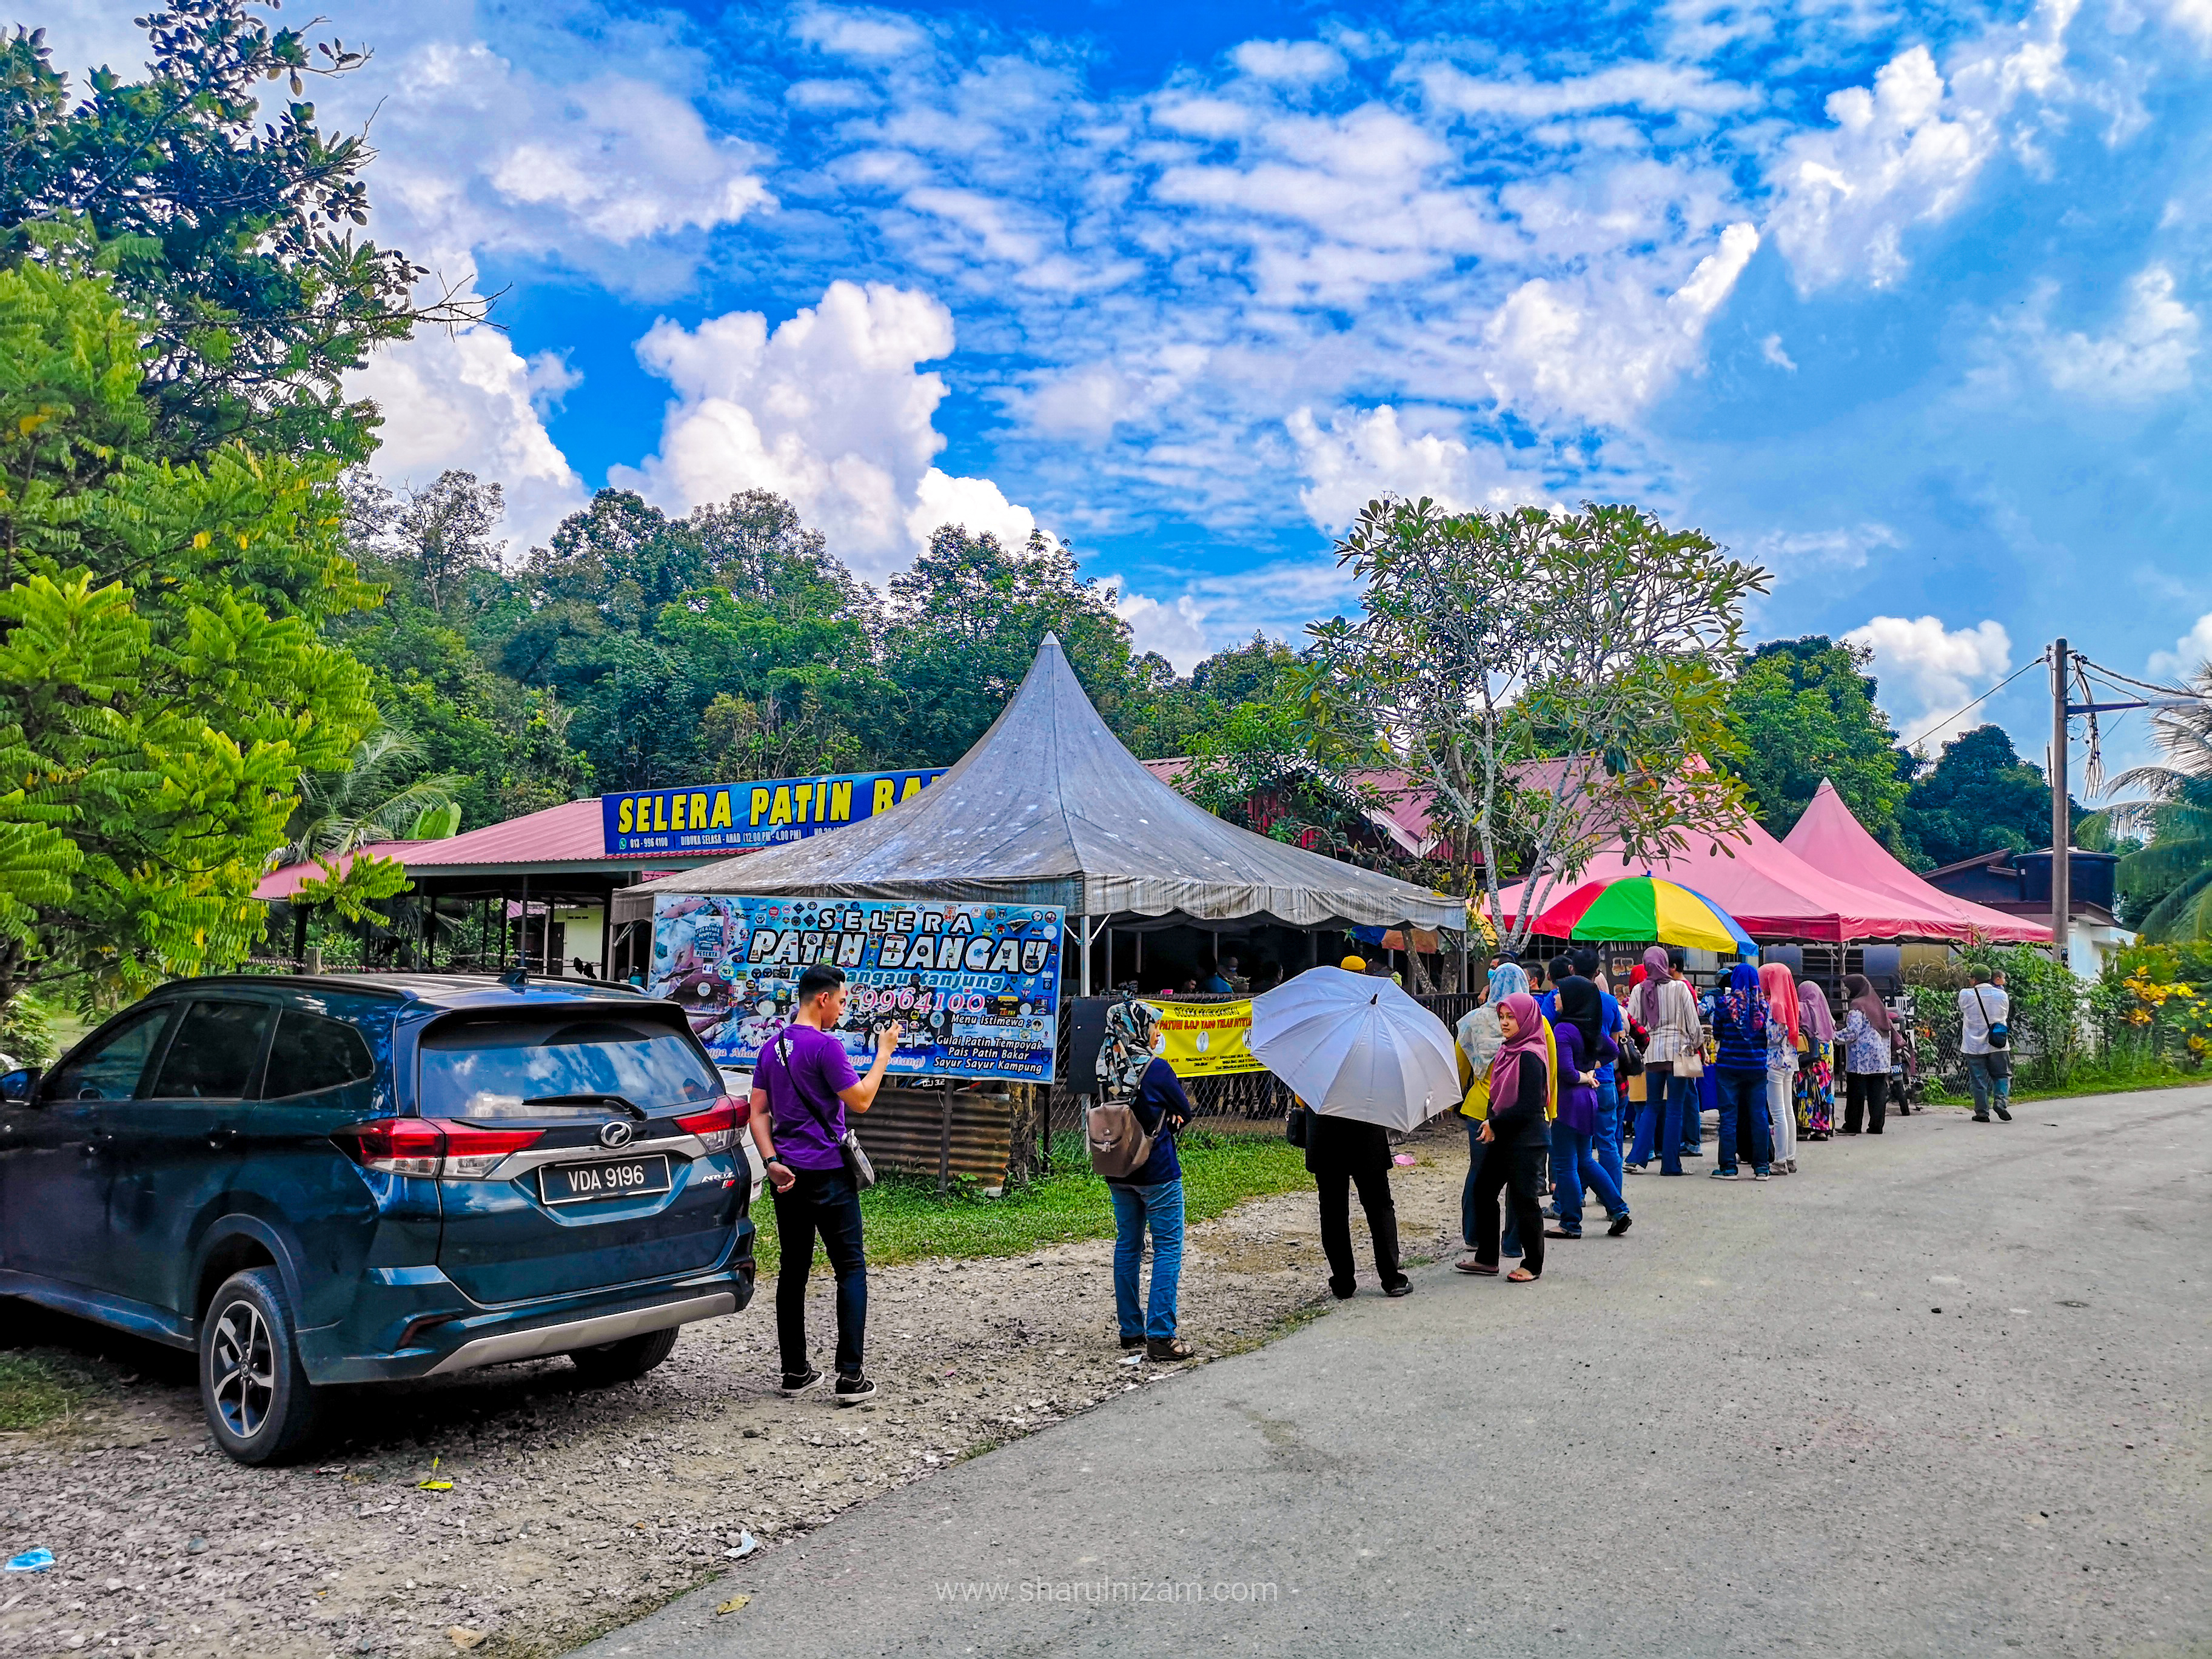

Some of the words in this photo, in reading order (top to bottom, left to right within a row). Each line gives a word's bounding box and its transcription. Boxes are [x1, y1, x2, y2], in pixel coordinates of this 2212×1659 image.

[618, 791, 732, 834] SELERA
[749, 781, 854, 826] PATIN
[871, 774, 942, 817] BA
[629, 839, 640, 848] 013
[643, 837, 655, 848] 996
[655, 837, 668, 847] 4100
[680, 835, 702, 846] DIBUKA
[702, 834, 722, 845] SELASA
[726, 833, 741, 843] AHAD
[819, 909, 974, 934] SELERA
[748, 929, 867, 967] PATIN
[877, 934, 1051, 975] BANGAU
[846, 970, 910, 986] angau
[919, 971, 1004, 990] tanjung
[951, 1014, 978, 1025] Menu
[980, 1014, 1025, 1028] Istimewa
[936, 1034, 962, 1045] Gulai
[965, 1036, 991, 1047] Patin
[995, 1037, 1044, 1051] Tempoyak
[948, 1047, 969, 1057] Pais
[971, 1048, 998, 1058] Patin
[1001, 1050, 1030, 1061] Bakar
[933, 1057, 963, 1068] Sayur
[965, 1058, 995, 1070] Sayur
[997, 1060, 1042, 1074] Kampung
[568, 1169, 602, 1191] VDA
[605, 1165, 645, 1187] 9196
